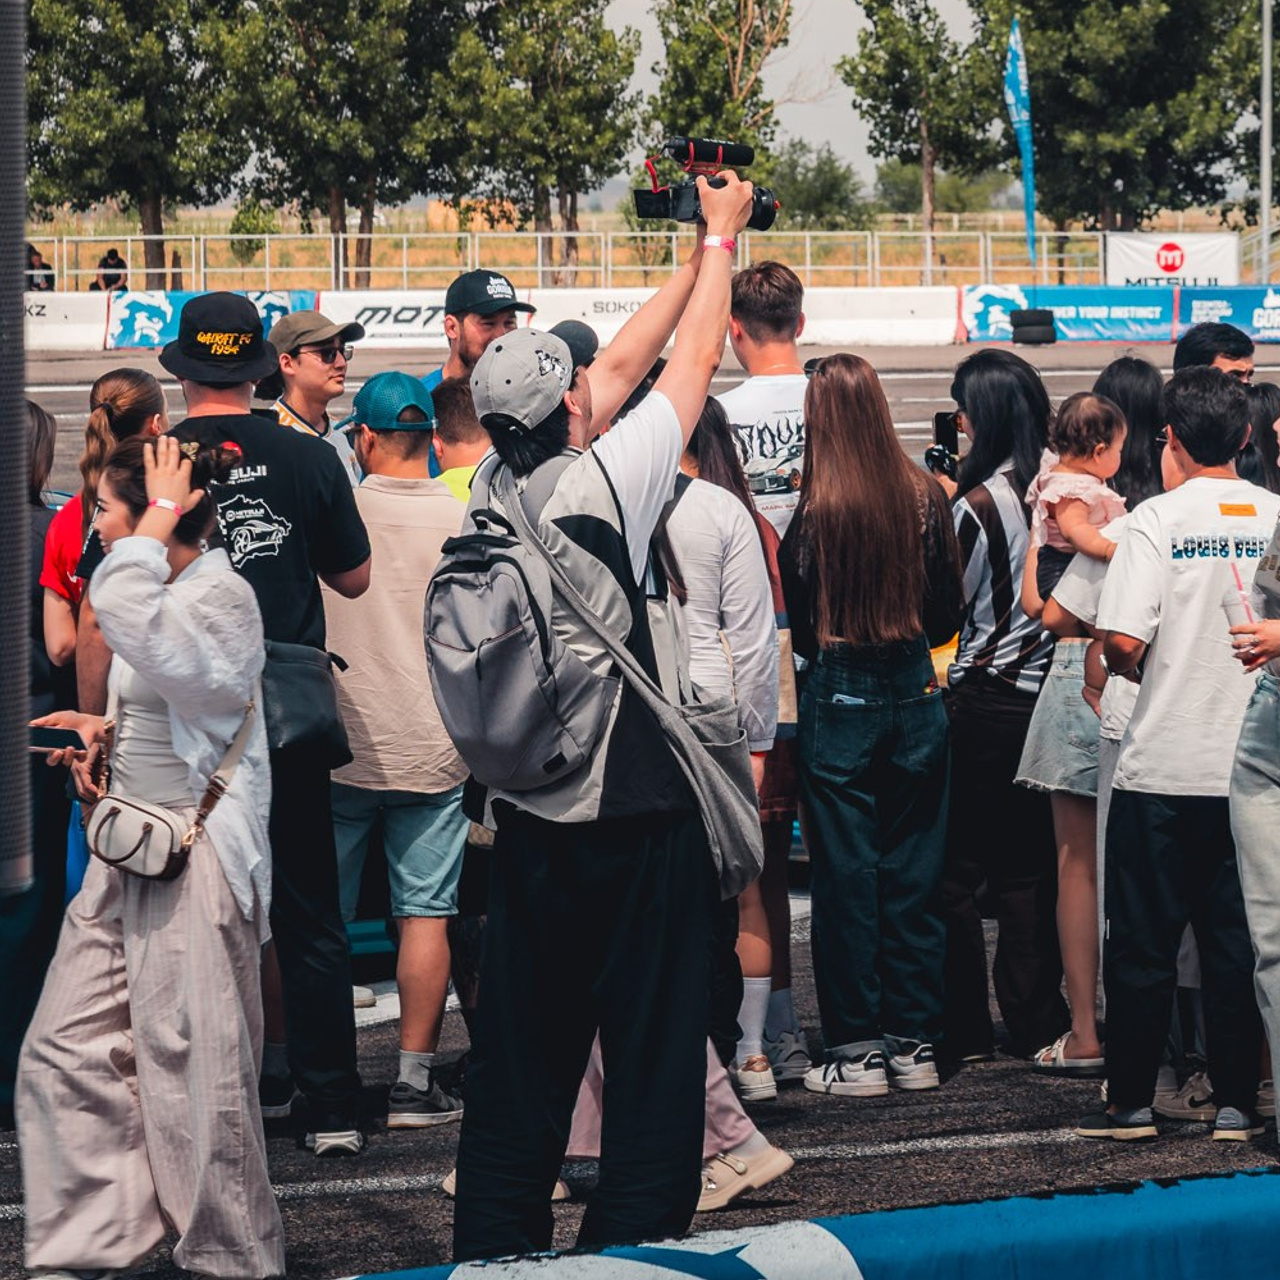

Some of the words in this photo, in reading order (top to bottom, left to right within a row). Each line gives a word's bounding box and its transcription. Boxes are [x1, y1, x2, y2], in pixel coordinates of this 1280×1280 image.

[1078, 306, 1109, 319] YOUR
[1110, 306, 1162, 319] INSTINCT
[211, 343, 240, 355] 1954
[1171, 535, 1230, 559] LOUIS
[1233, 534, 1270, 559] VUI
